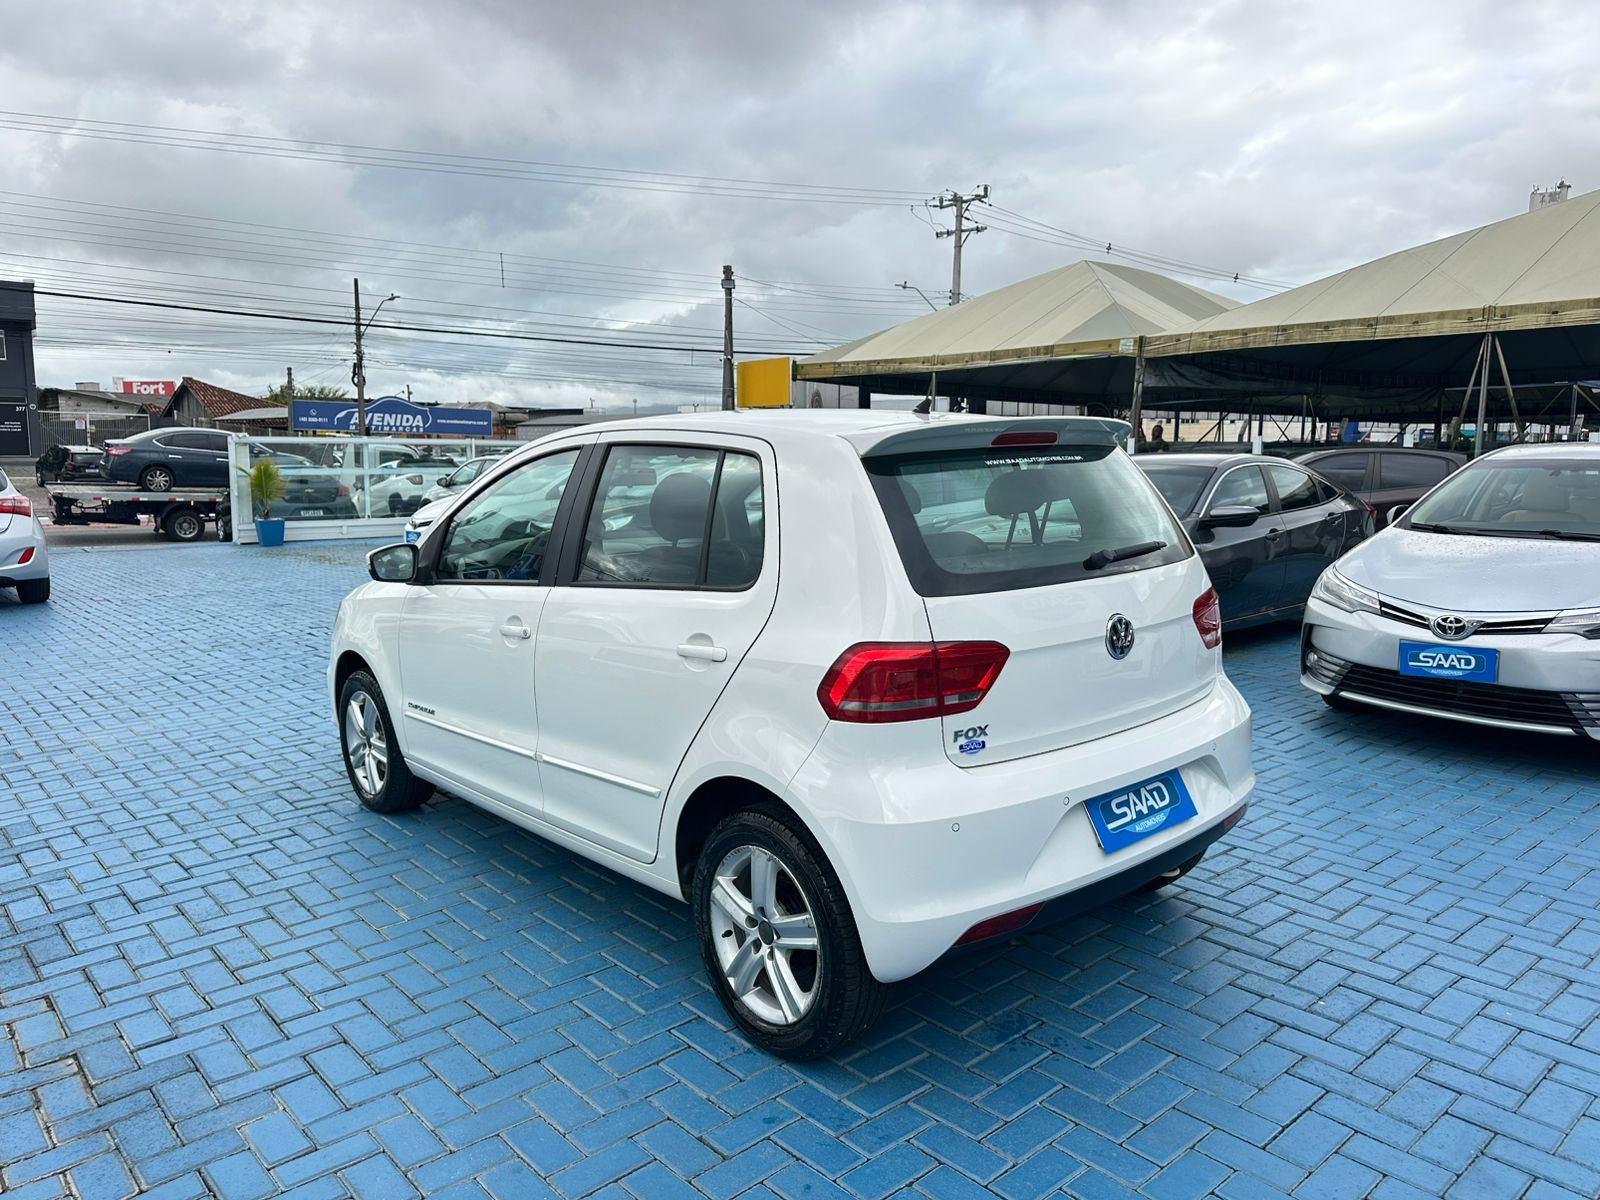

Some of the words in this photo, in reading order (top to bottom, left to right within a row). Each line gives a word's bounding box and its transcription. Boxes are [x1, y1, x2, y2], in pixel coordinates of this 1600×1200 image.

[132, 382, 165, 395] Fort
[349, 412, 424, 427] AVENIDA
[349, 424, 424, 433] MTIMARCAS
[1408, 652, 1476, 670] SAAD
[953, 724, 989, 743] FOX
[1106, 781, 1170, 830] SAAD
